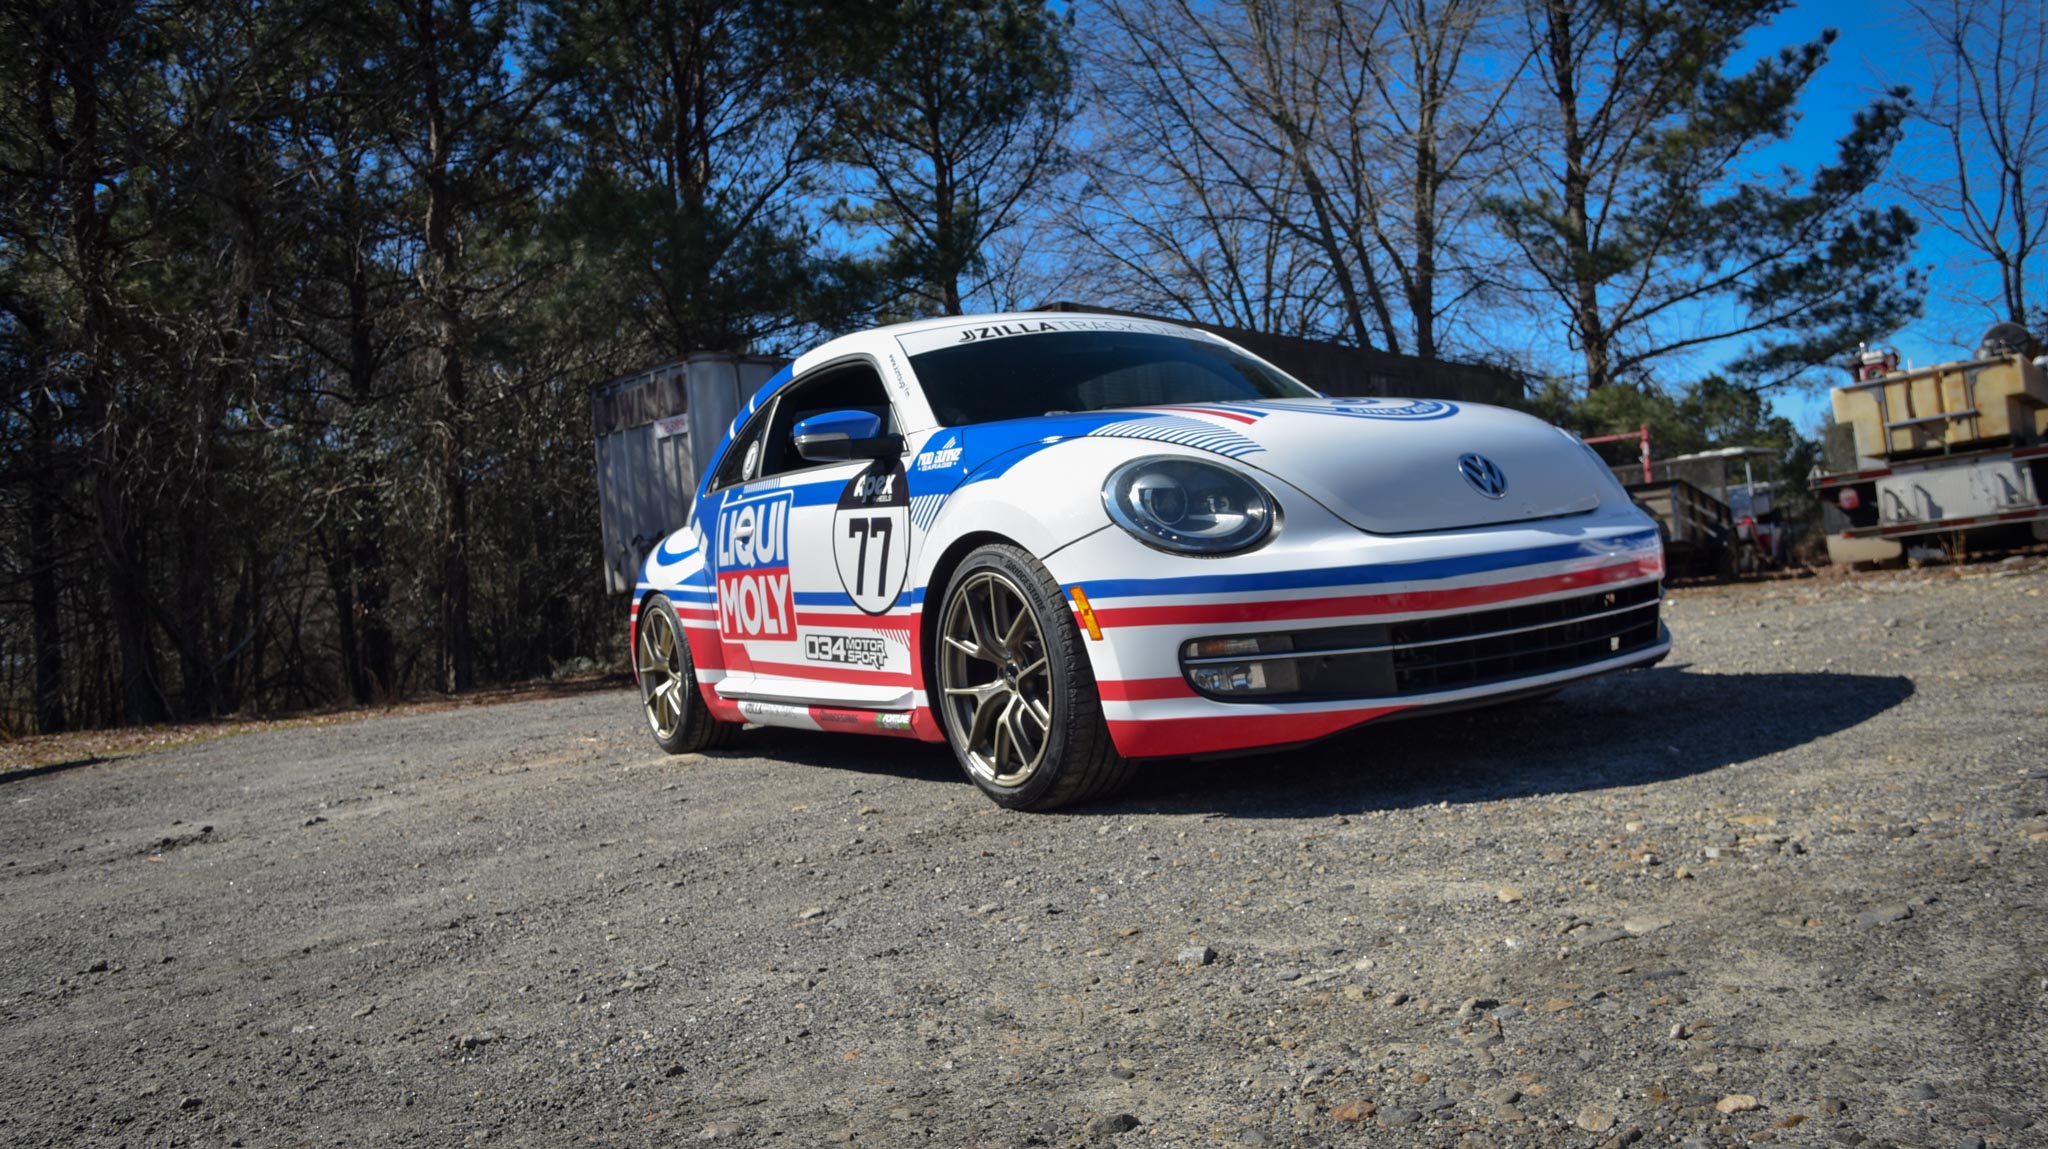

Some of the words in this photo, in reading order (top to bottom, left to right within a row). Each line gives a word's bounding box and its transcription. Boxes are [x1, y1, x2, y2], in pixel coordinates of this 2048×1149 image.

[718, 499, 788, 569] LIQUI
[848, 516, 893, 598] 77
[719, 573, 789, 636] MOLY
[1004, 559, 1047, 612] BRIDGESTONE
[805, 634, 846, 662] 034
[845, 637, 886, 652] MOTOR
[847, 649, 886, 669] SPORT
